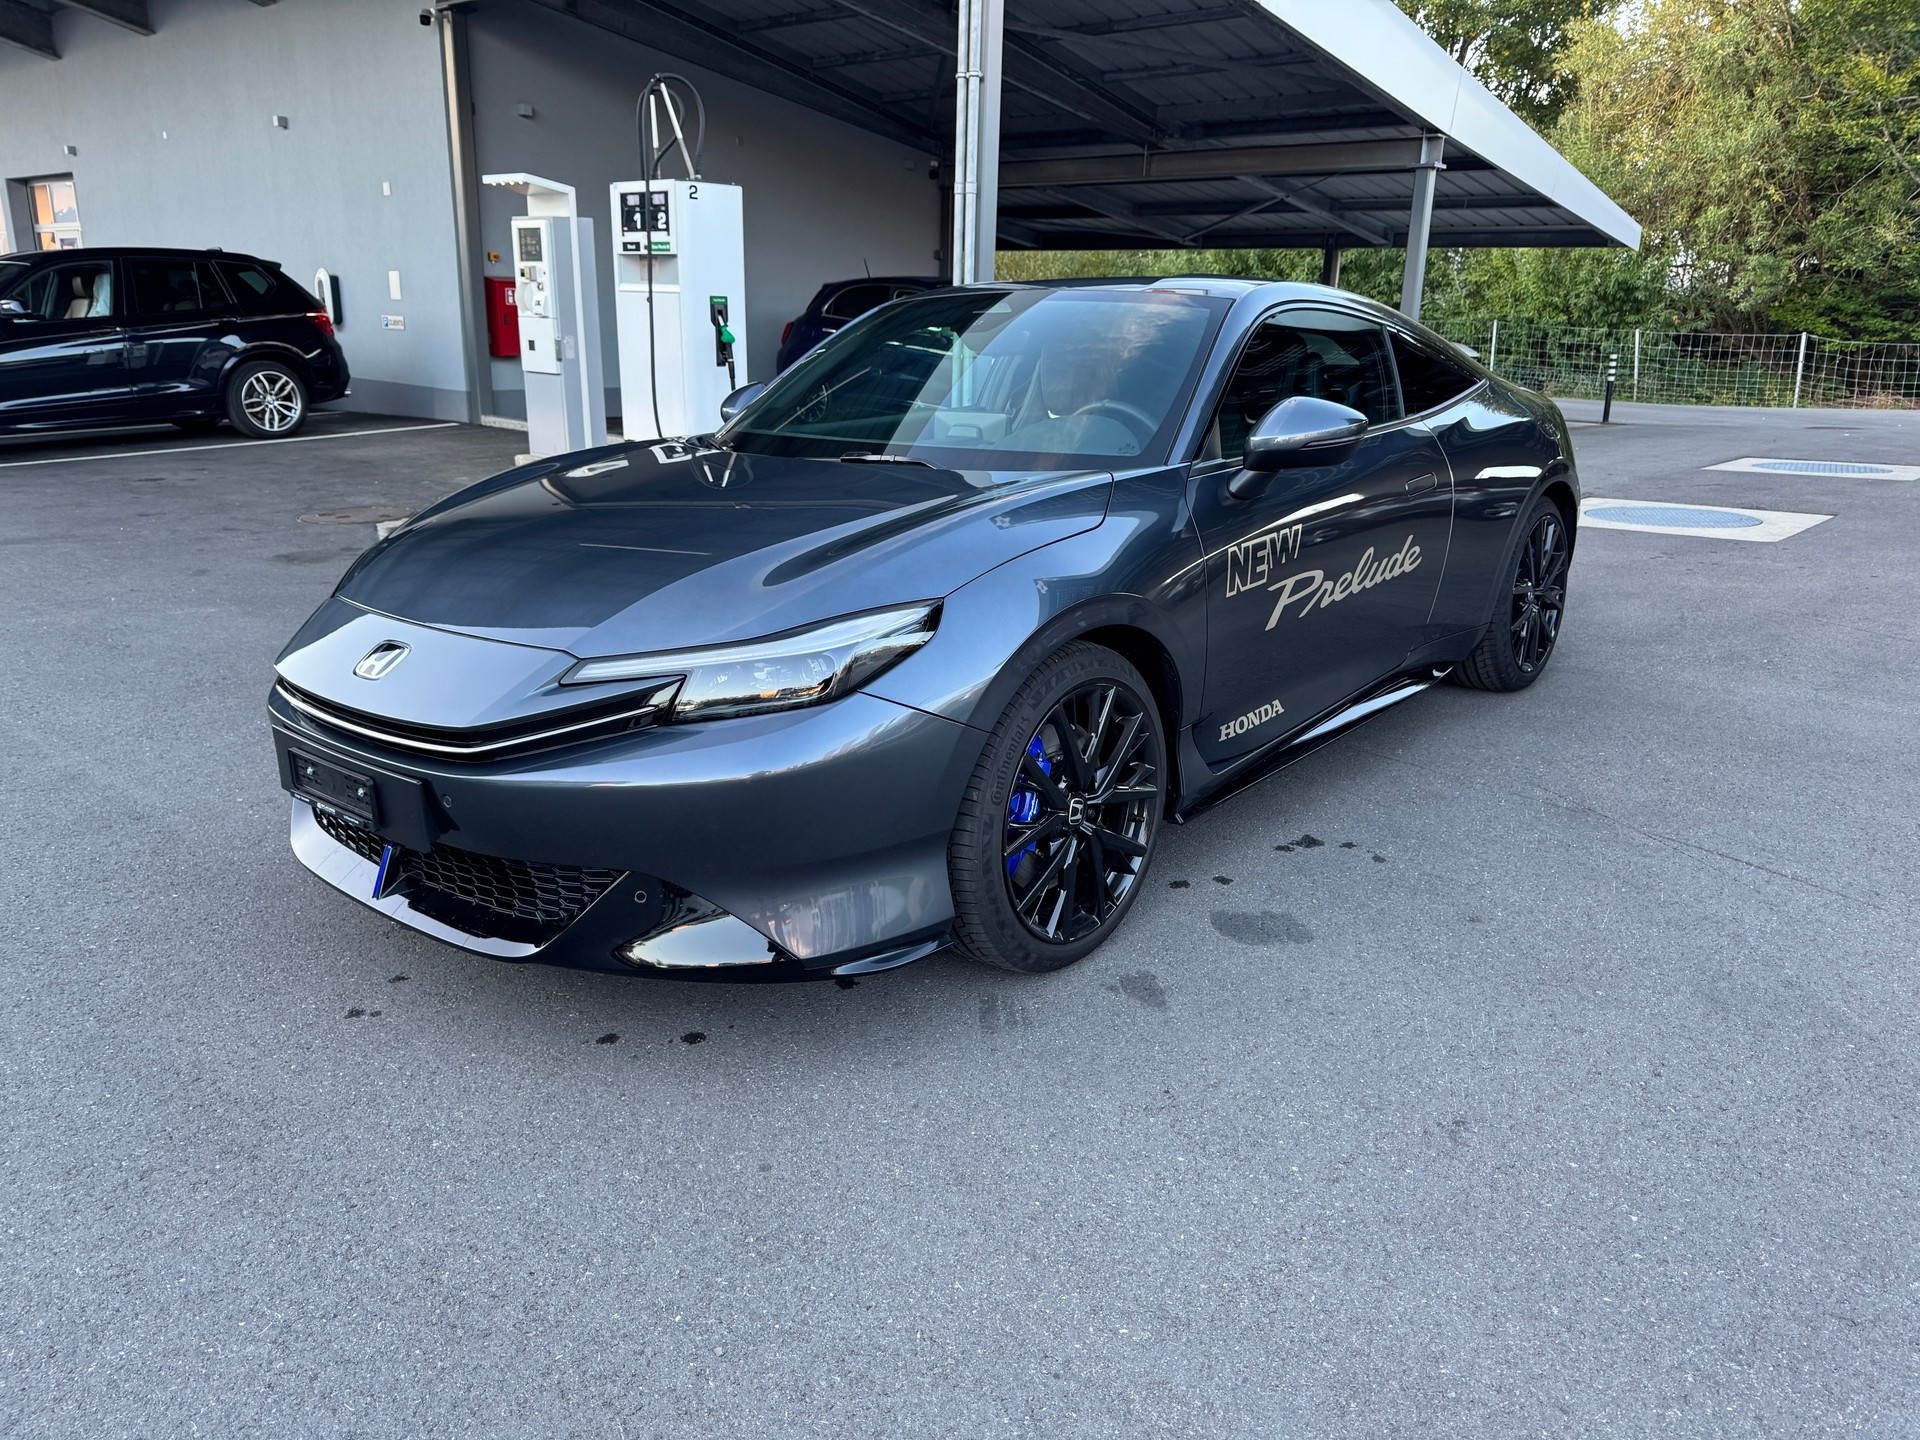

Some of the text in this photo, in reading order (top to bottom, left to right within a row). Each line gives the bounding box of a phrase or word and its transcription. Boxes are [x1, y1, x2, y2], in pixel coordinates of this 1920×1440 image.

[689, 185, 698, 200] 2
[633, 212, 642, 230] 1
[657, 211, 667, 229] 2
[1226, 523, 1303, 598] NEW
[1265, 534, 1423, 632] Prelude
[1218, 699, 1285, 742] HONDA
[990, 724, 1026, 807] Continental
